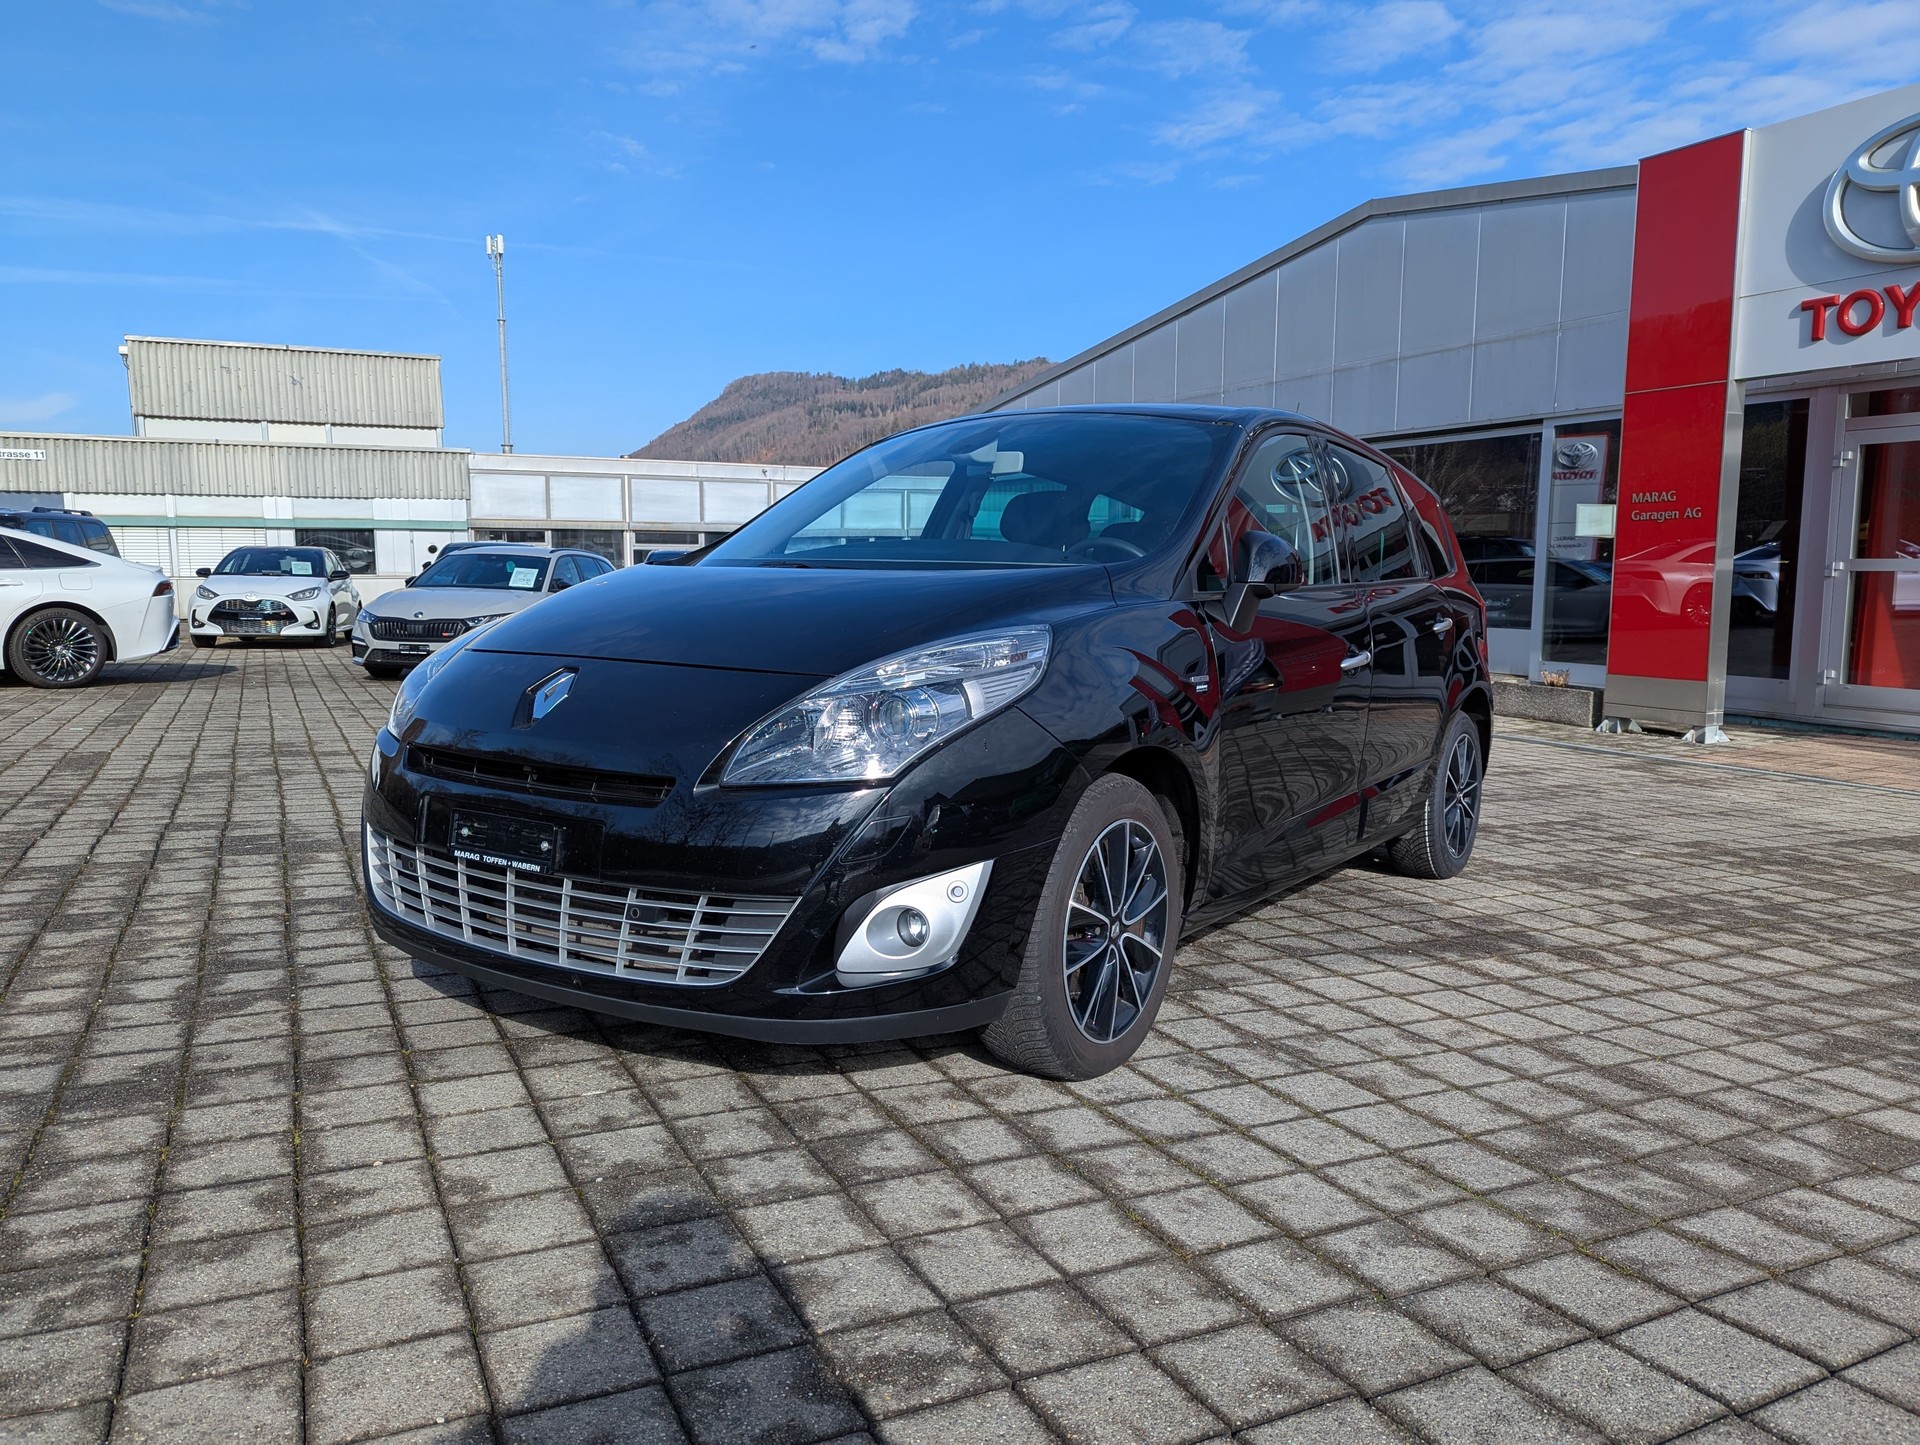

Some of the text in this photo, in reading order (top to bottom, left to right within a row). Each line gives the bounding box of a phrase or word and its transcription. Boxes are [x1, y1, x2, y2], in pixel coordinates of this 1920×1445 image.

[1801, 281, 1920, 341] TOY
[1632, 490, 1676, 503] MARAG
[1631, 507, 1701, 522] Garagen AG
[454, 850, 480, 860] MARAG
